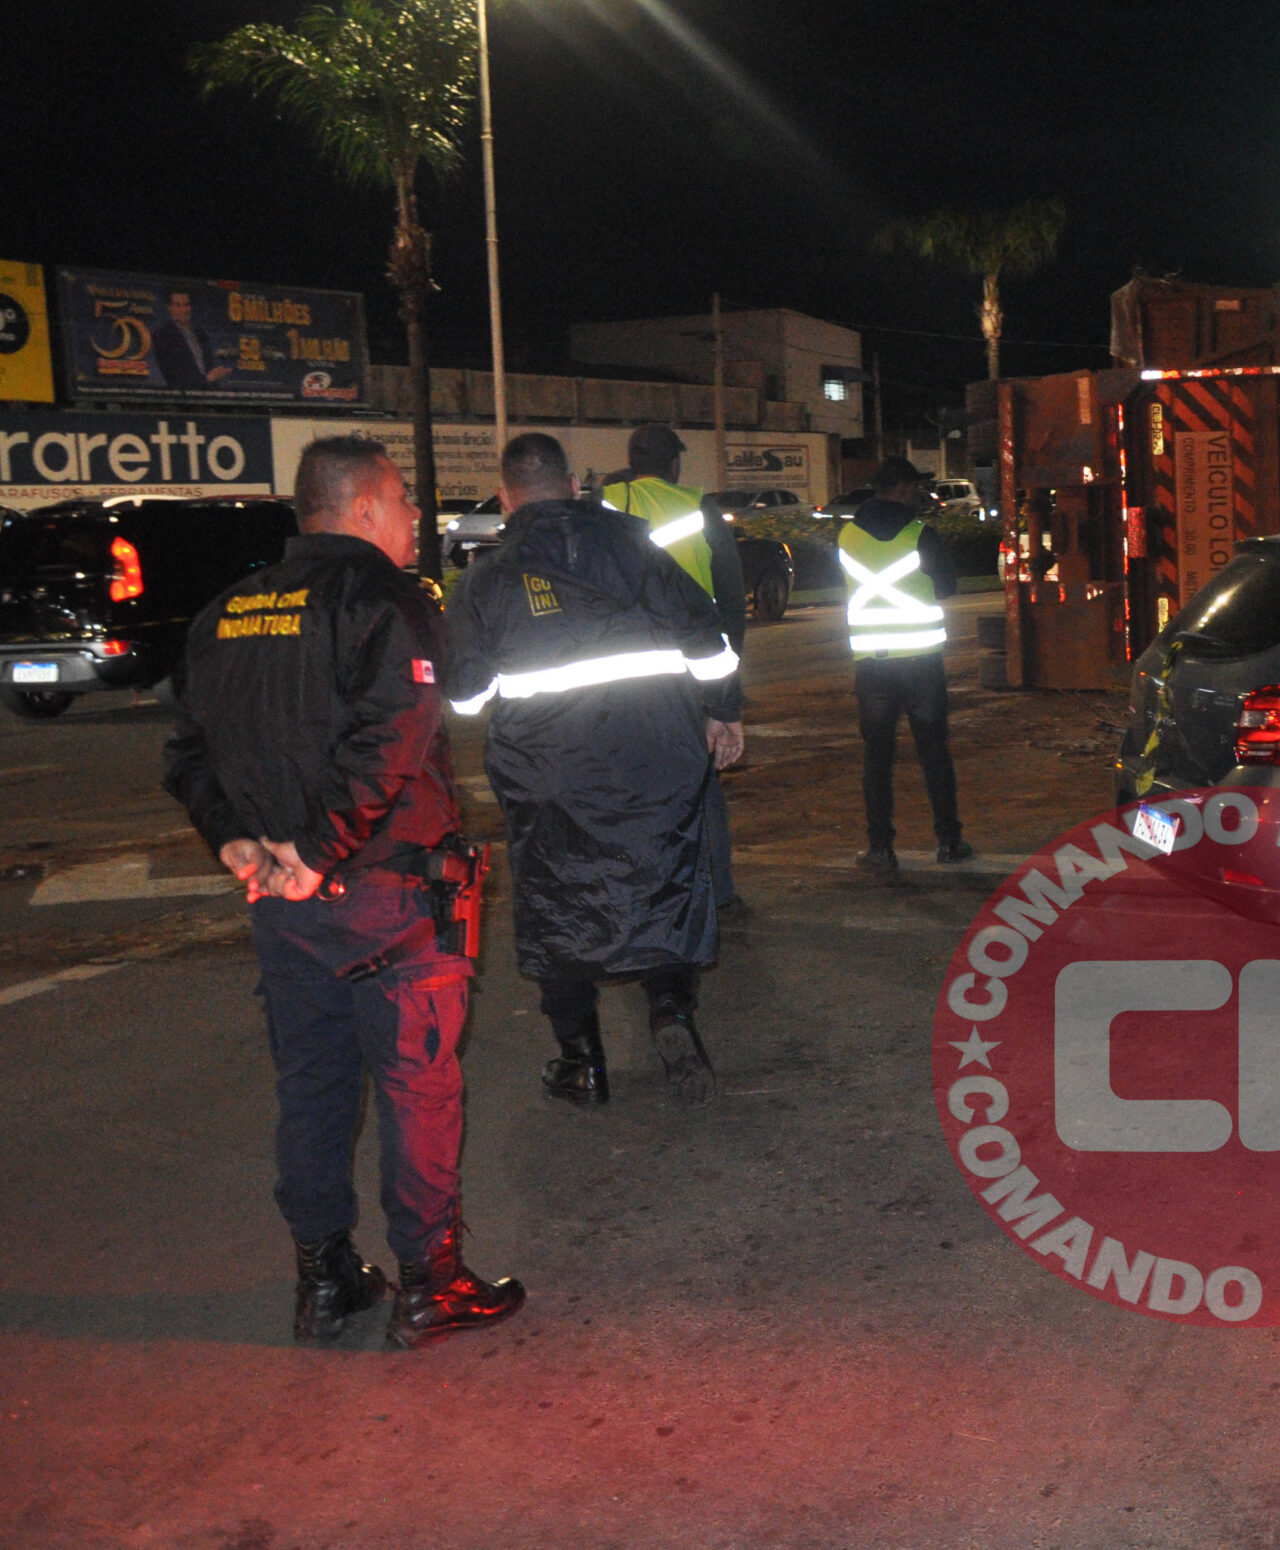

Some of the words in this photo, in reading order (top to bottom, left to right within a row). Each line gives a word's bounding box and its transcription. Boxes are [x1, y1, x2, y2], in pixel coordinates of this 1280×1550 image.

[0, 421, 245, 482] raretto
[1207, 434, 1232, 530] VEÍCULO
[1209, 538, 1229, 572] LO
